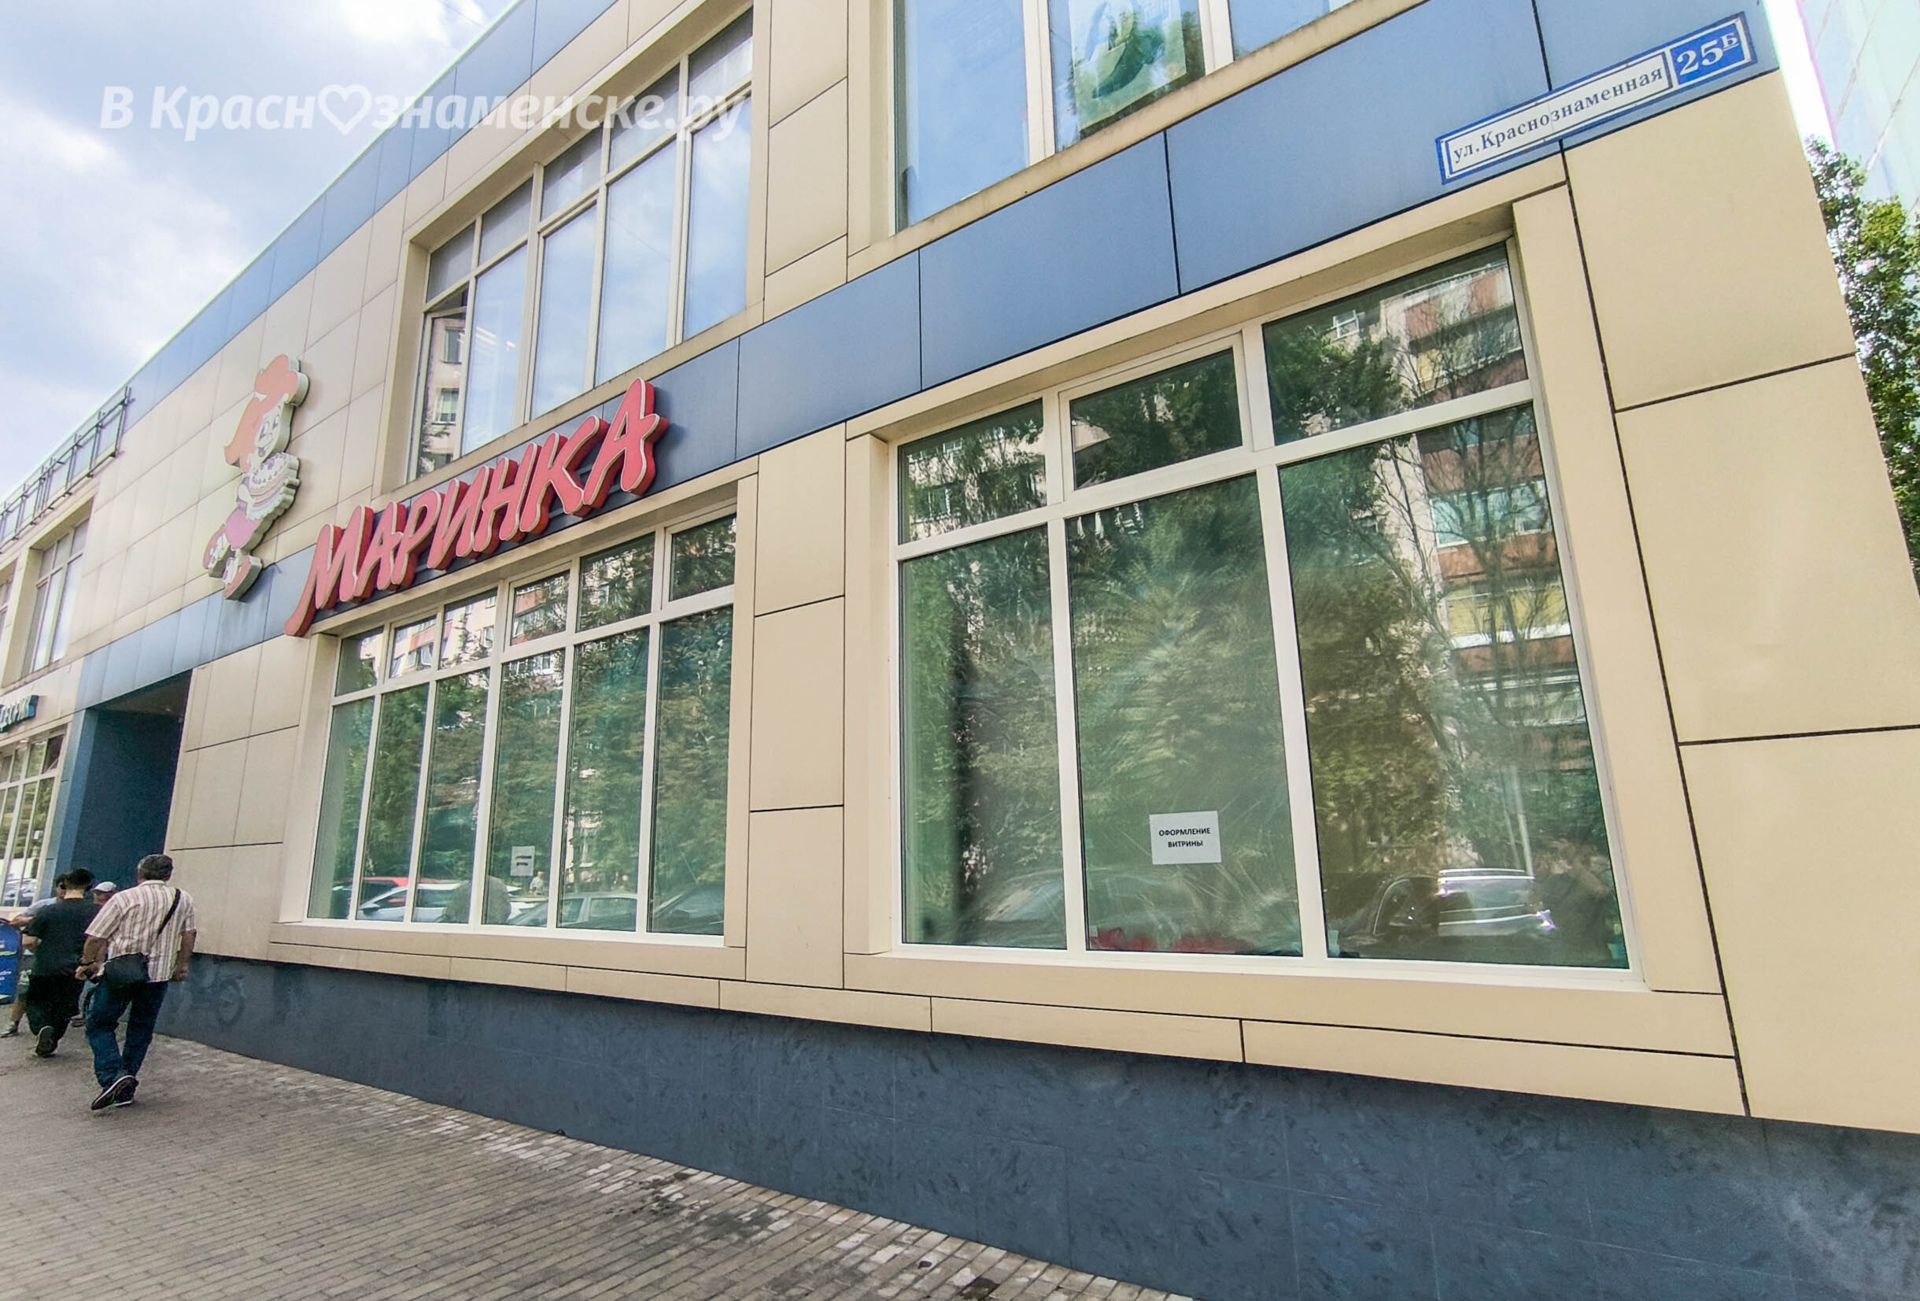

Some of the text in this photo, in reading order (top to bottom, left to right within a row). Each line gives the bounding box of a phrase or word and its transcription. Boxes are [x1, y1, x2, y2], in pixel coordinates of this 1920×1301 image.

[285, 377, 667, 636] МАРИНКА
[1158, 827, 1211, 837] ОФОРМЛЕНИЕ
[1167, 840, 1204, 848] ВИТРИНЫ
